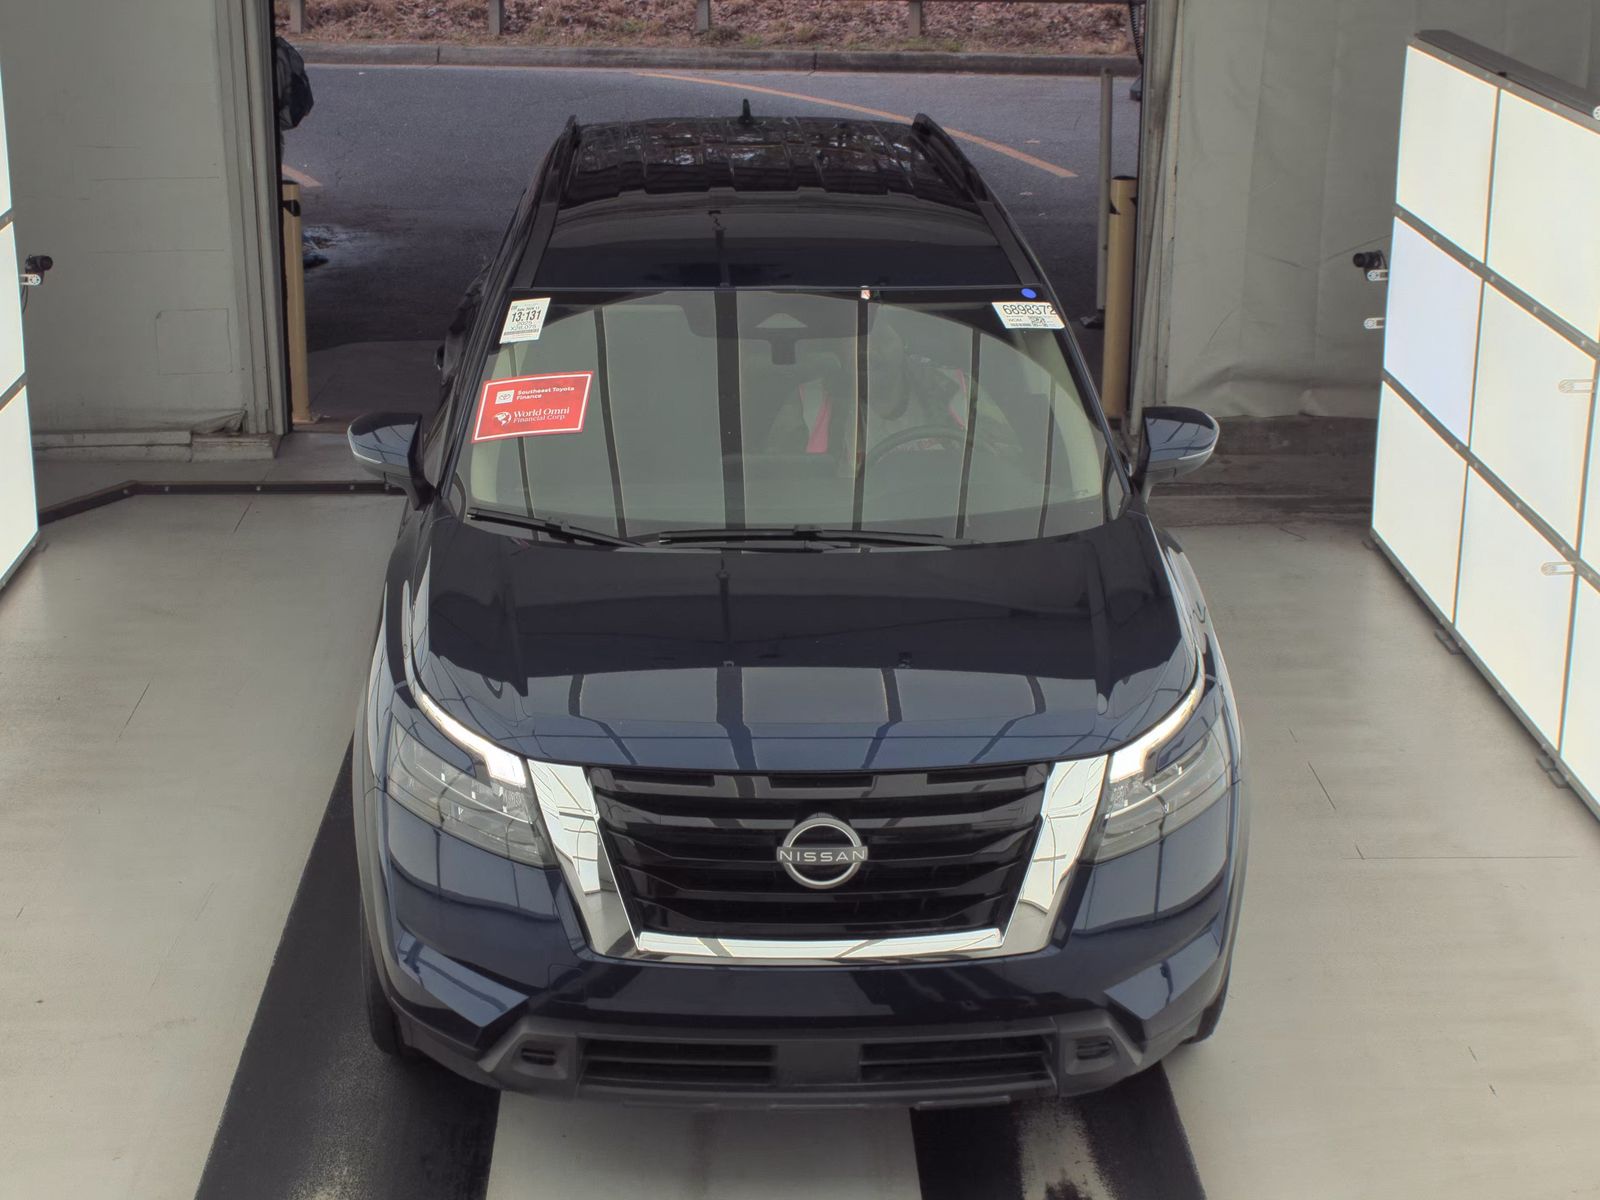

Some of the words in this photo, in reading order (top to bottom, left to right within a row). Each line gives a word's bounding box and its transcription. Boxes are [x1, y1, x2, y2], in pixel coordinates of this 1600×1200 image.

[512, 310, 541, 322] 13:131
[513, 408, 542, 417] World
[543, 407, 570, 415] Omni
[513, 415, 546, 423] Financial
[779, 850, 865, 862] NISSAN
